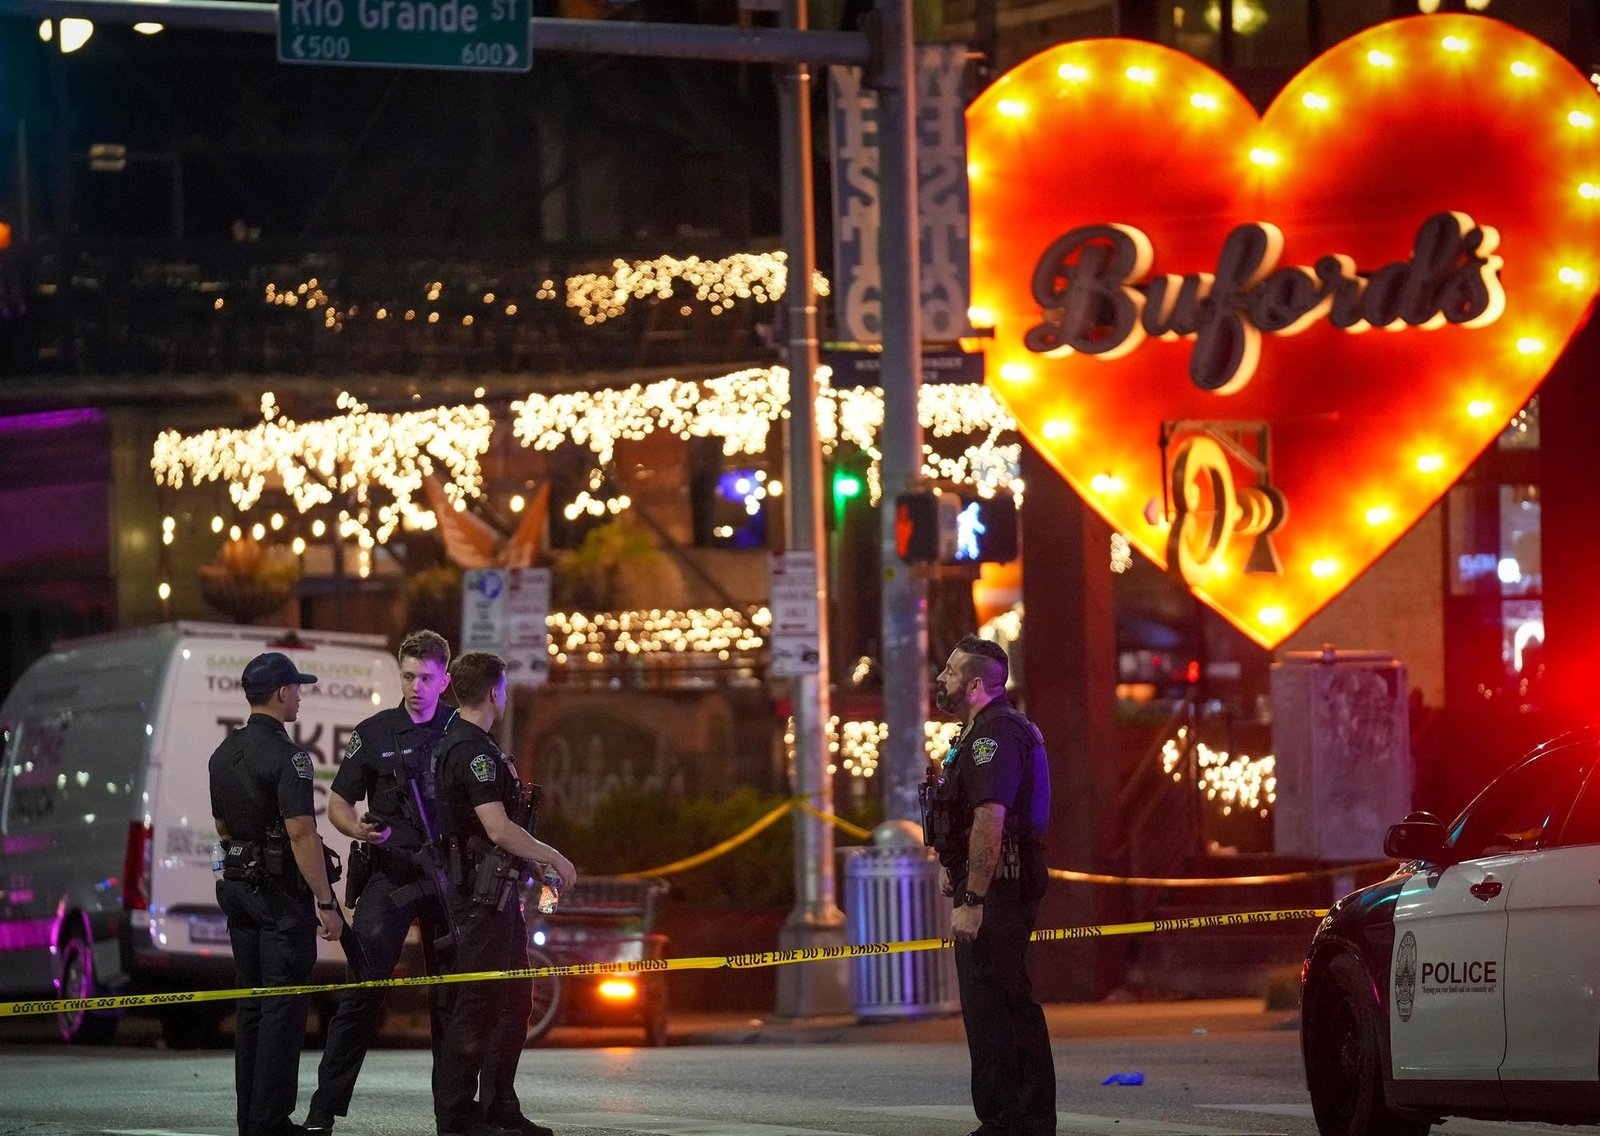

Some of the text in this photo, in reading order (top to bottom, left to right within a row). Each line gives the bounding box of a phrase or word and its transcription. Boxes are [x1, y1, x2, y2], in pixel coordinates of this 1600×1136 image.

[292, 0, 516, 33] Rio Grande ST
[308, 36, 501, 65] 500 600
[1024, 211, 1503, 395] Buford's
[1247, 913, 1272, 923] NOT
[726, 951, 768, 967] POLICE
[771, 949, 798, 962] LINE
[823, 946, 846, 957] NOT
[850, 943, 890, 955] CROSS
[1422, 962, 1496, 983] POLICE
